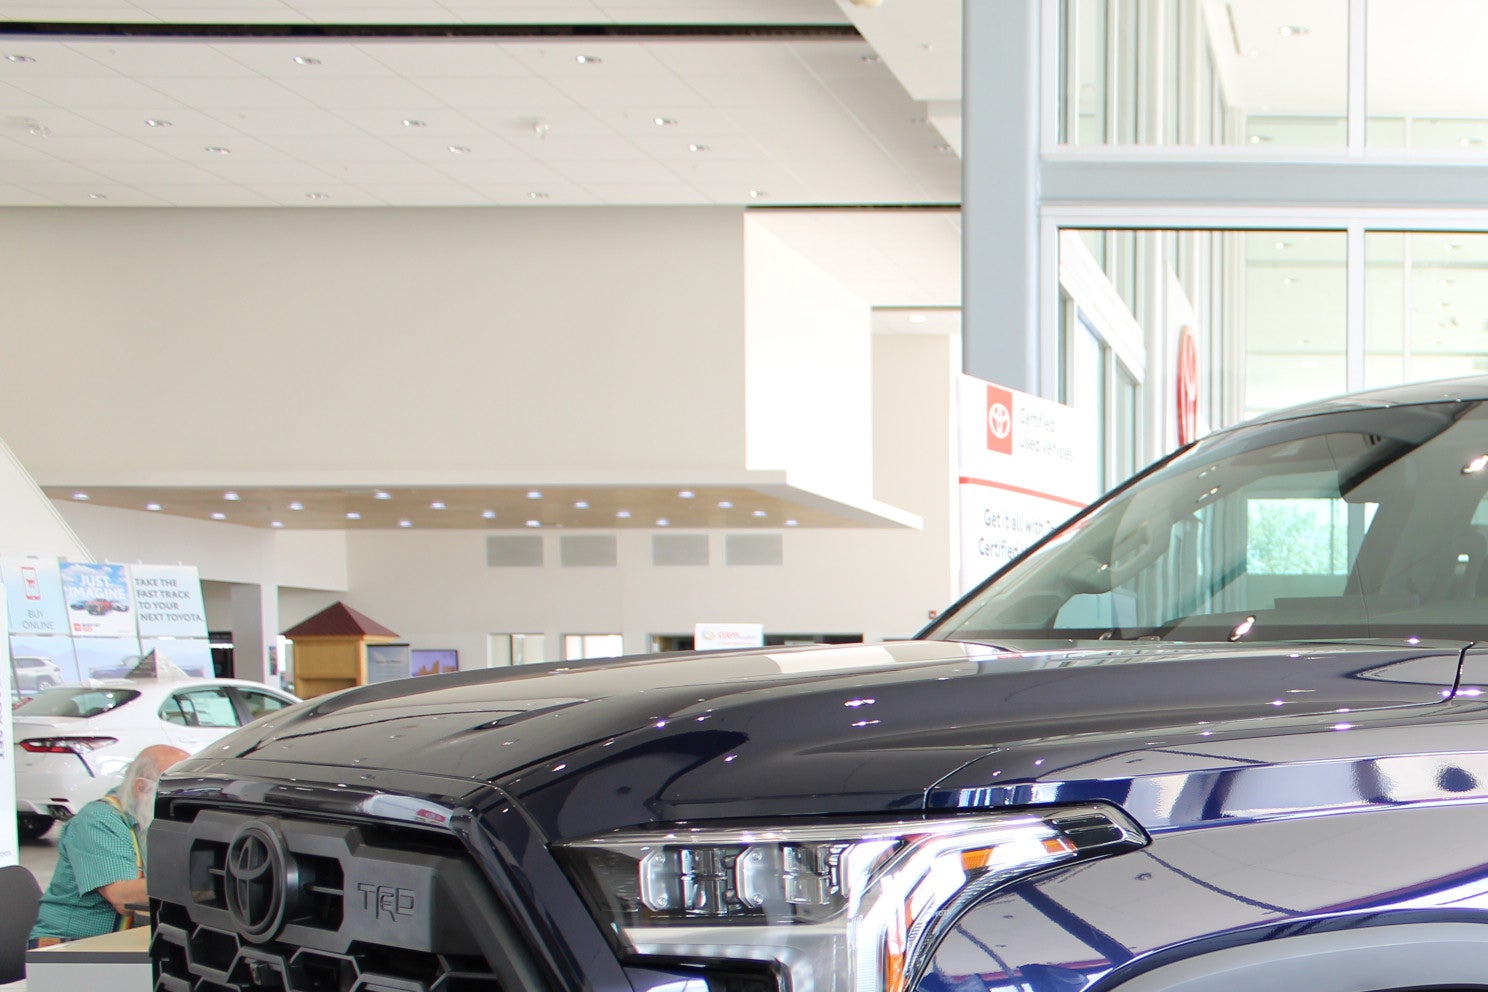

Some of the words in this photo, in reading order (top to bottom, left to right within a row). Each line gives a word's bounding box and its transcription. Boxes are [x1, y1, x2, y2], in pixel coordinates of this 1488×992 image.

[1019, 407, 1055, 433] Certified
[983, 507, 1001, 528] Get
[1002, 513, 1010, 530] it
[1011, 515, 1023, 532] all
[1025, 517, 1044, 536] with
[978, 536, 1019, 559] Certified
[80, 574, 111, 588] JUST
[134, 578, 158, 587] TAKE
[159, 578, 178, 588] THE
[68, 586, 126, 599] IMAGINE
[136, 589, 158, 599] FAST
[159, 589, 191, 600] TRACK
[137, 600, 151, 610] TO
[153, 600, 179, 611] YOUR
[27, 608, 45, 619] BUY
[140, 612, 164, 621] NEXT
[22, 619, 55, 630] ONLINE
[356, 882, 416, 923] TRD
